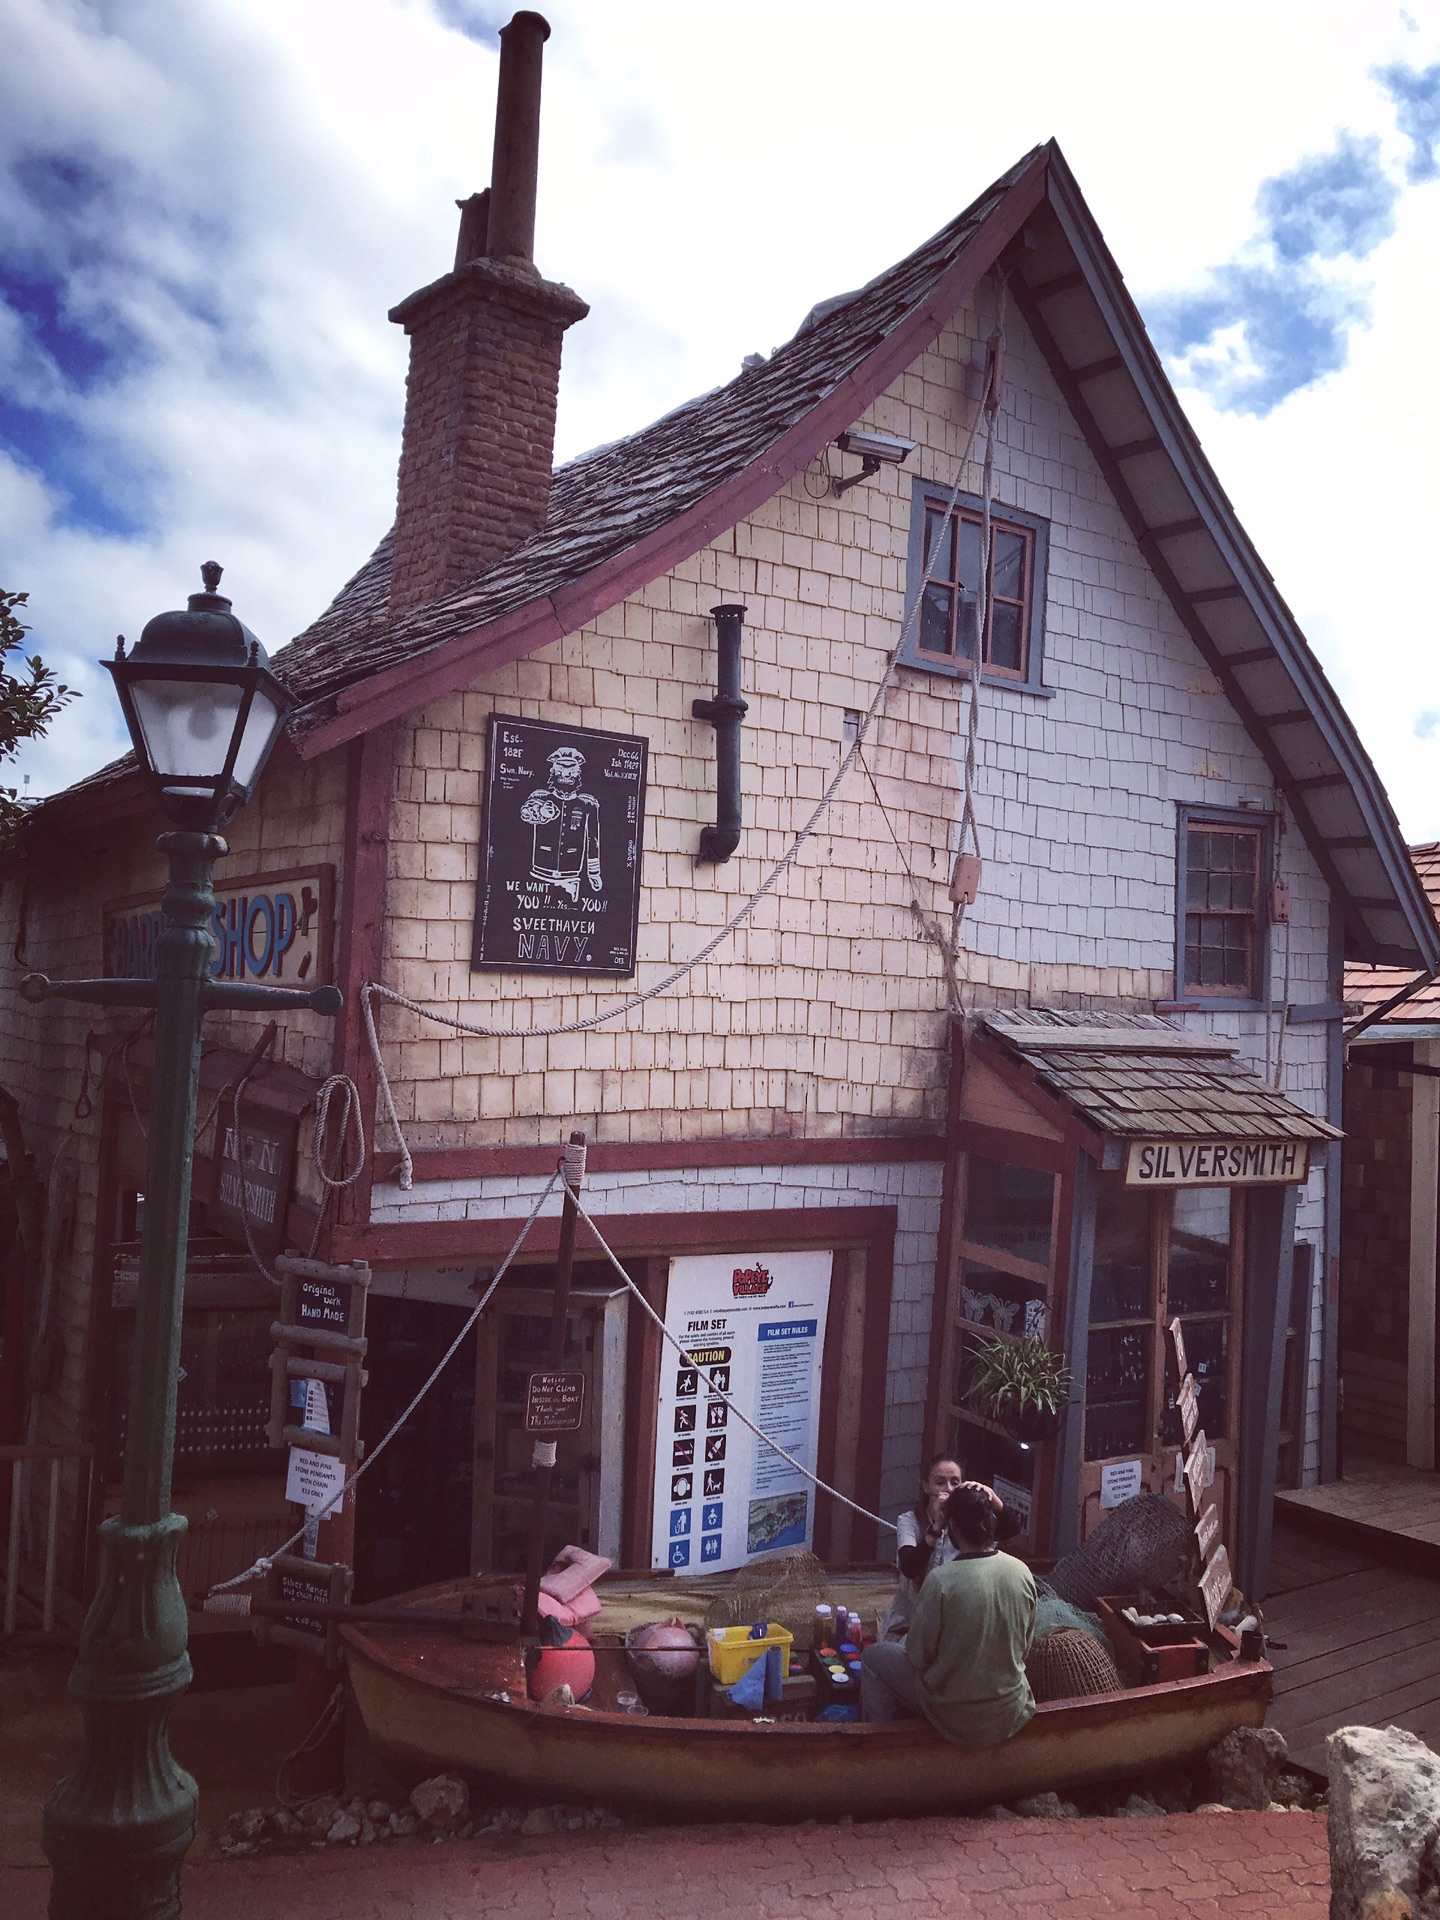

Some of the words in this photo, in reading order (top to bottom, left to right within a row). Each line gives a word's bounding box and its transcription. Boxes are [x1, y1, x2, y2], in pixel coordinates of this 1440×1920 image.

[503, 731, 523, 743] Est.
[506, 881, 520, 891] WE
[526, 881, 550, 893] WANT
[513, 917, 595, 934] SWEETHAVEN
[110, 911, 168, 978] BARB
[211, 893, 297, 978] SHOP
[1139, 1144, 1297, 1179] SILVERSMITH
[733, 1269, 769, 1285] POPEYE
[302, 1283, 335, 1296] Original
[733, 1283, 768, 1296] VILLAGE
[688, 1320, 708, 1331] FILM
[711, 1319, 727, 1330] SET
[767, 1328, 780, 1336] FILM
[781, 1327, 791, 1335] SET
[791, 1326, 808, 1334] RULES
[687, 1350, 725, 1364] CAUTION
[300, 1457, 309, 1465] RED
[309, 1460, 319, 1468] AND
[295, 1465, 309, 1474] STONE
[310, 1469, 336, 1481] PENDANTS
